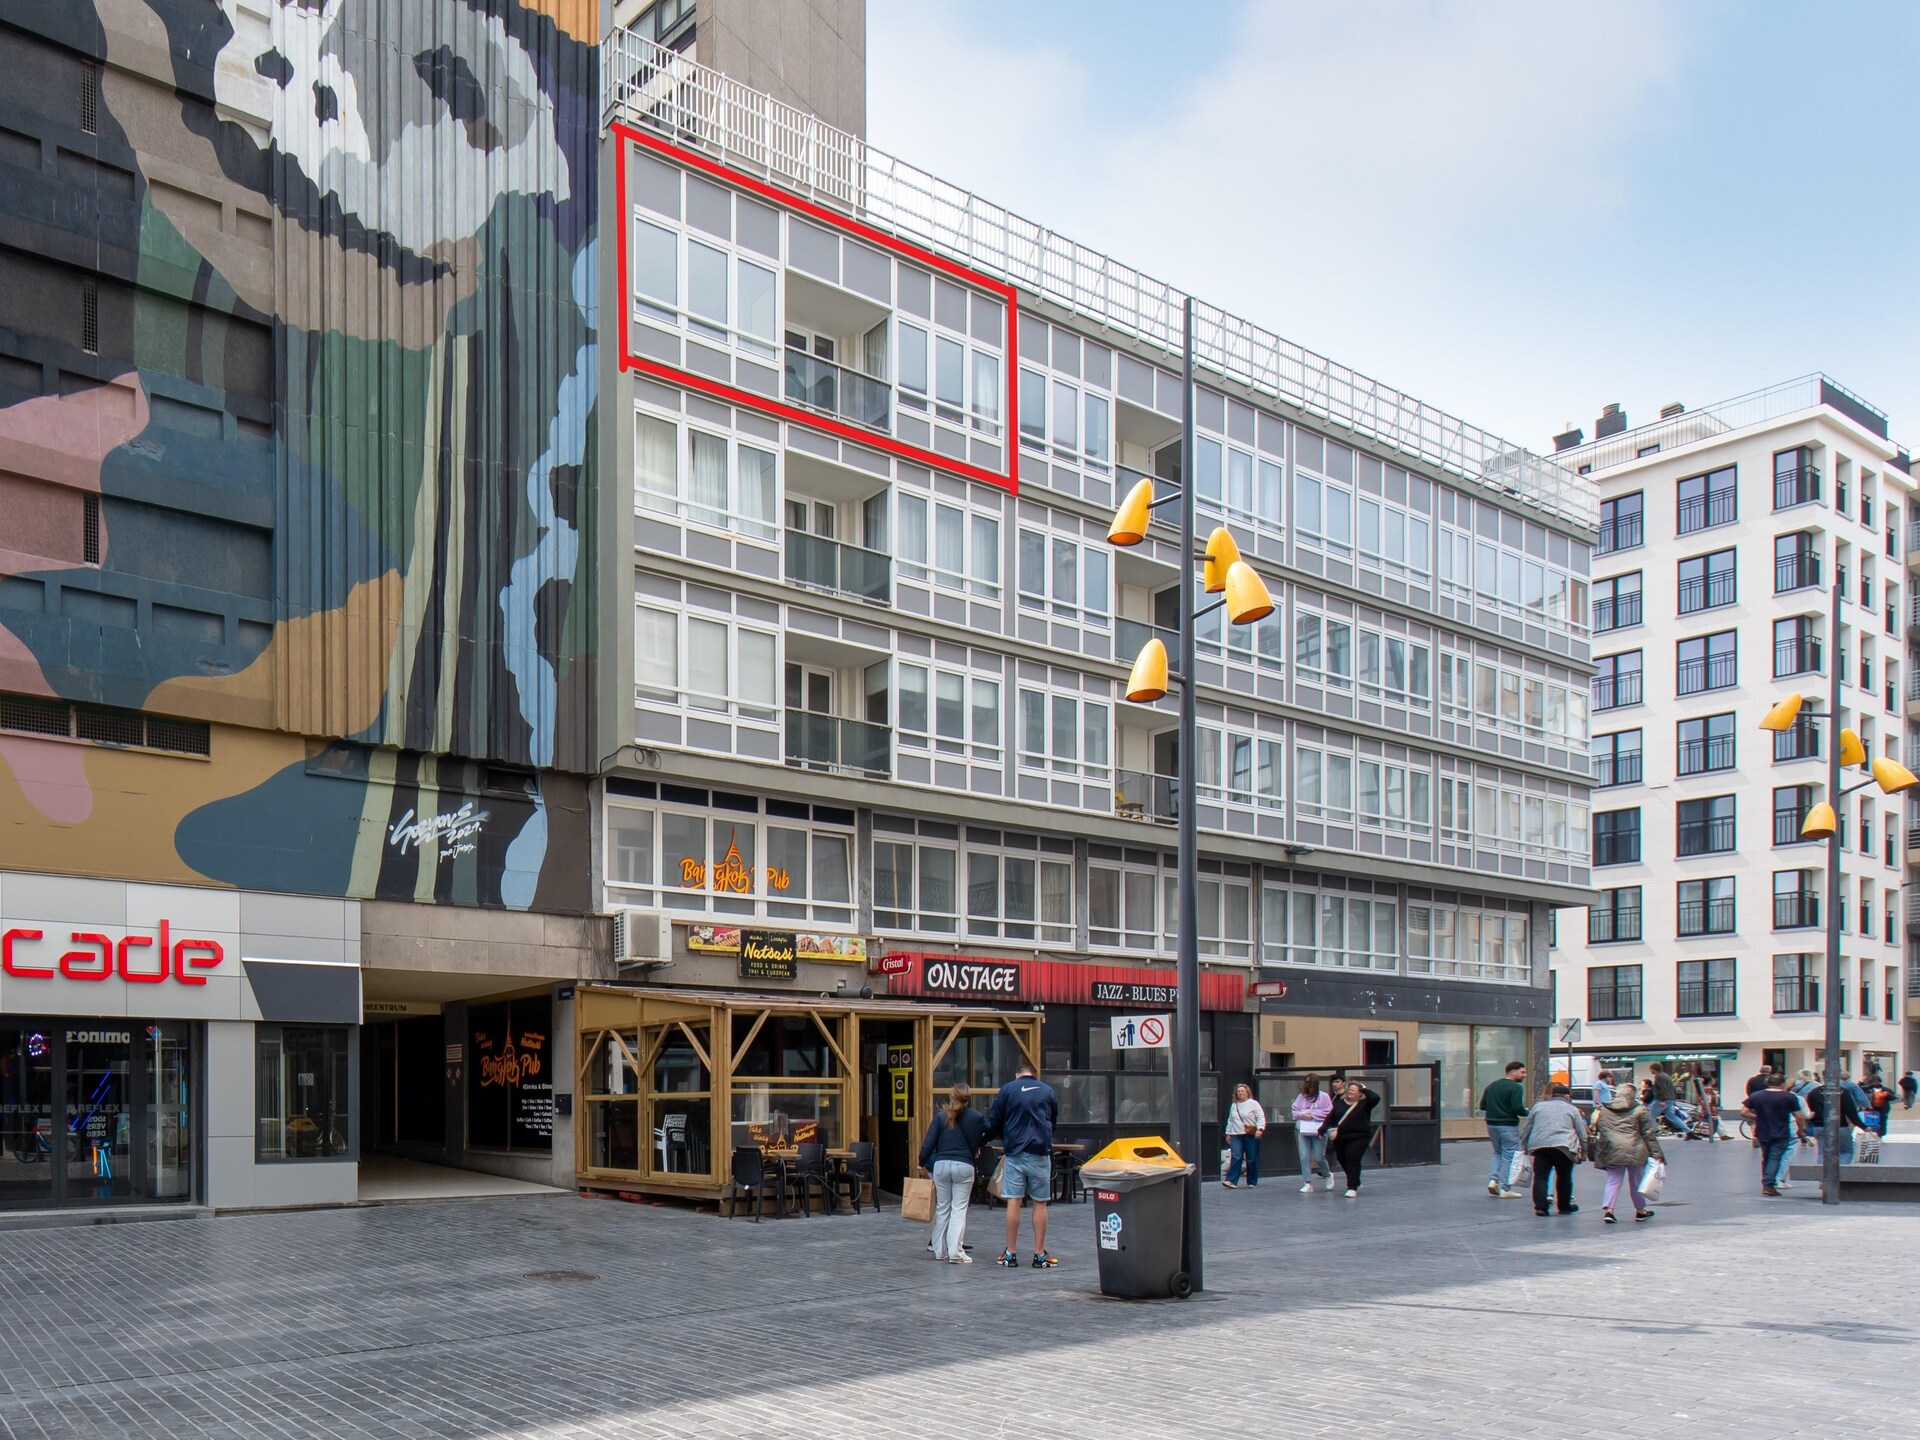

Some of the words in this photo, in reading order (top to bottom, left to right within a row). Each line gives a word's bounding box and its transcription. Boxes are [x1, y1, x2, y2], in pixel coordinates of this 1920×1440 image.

[743, 942, 794, 961] Natsasi
[882, 957, 904, 971] Cristal
[927, 962, 957, 989] ON
[958, 966, 1017, 992] STAGE
[1096, 984, 1124, 1000] JAZZ
[1131, 986, 1167, 1002] BLUES
[520, 1052, 541, 1077] Pub
[78, 1104, 120, 1113] REFLEX
[1098, 1192, 1115, 1200] SULO
